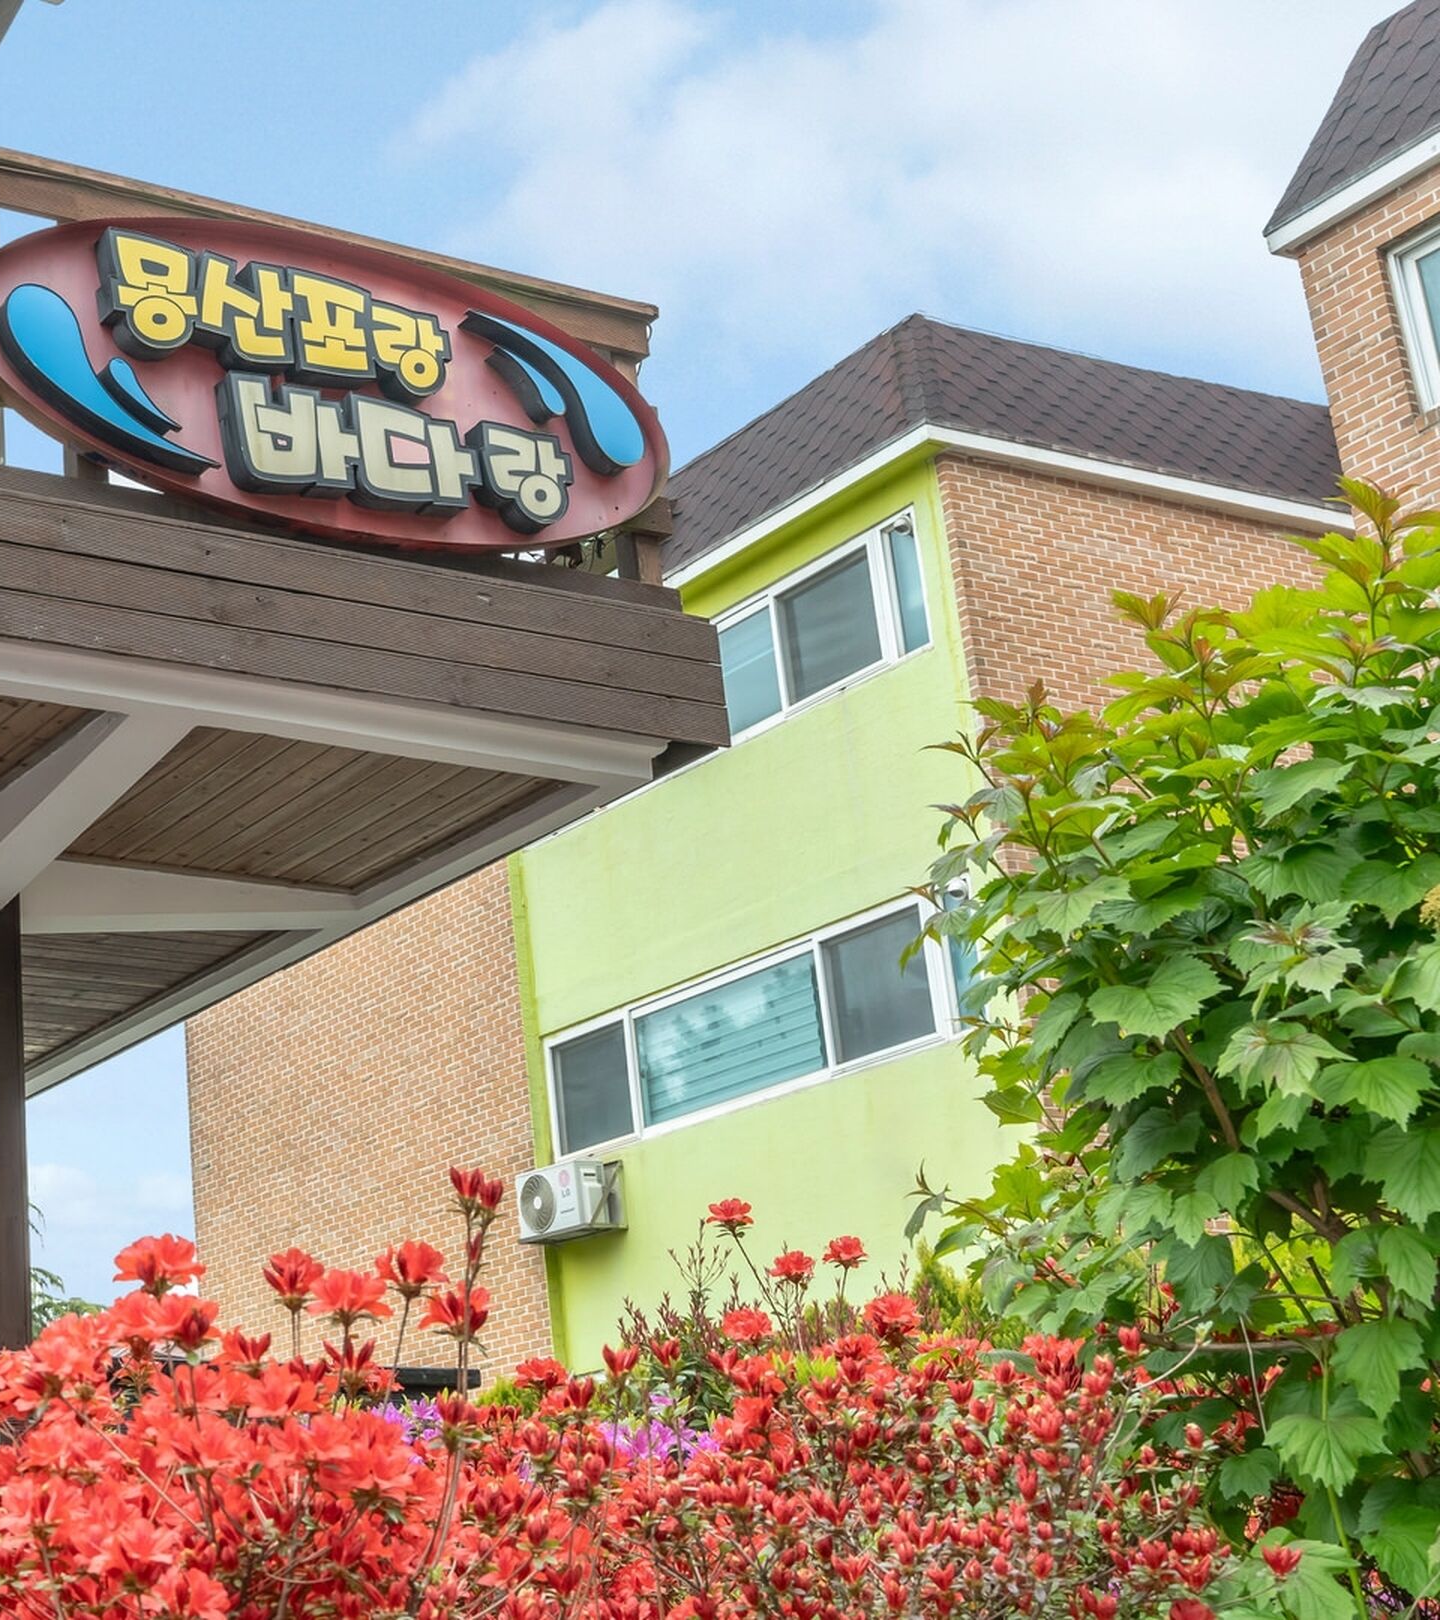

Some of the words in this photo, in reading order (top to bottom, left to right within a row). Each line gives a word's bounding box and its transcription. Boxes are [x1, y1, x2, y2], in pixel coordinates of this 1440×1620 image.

[112, 234, 446, 389] 몽산포랑
[237, 380, 569, 519] 바다랑
[561, 1188, 571, 1198] LG
